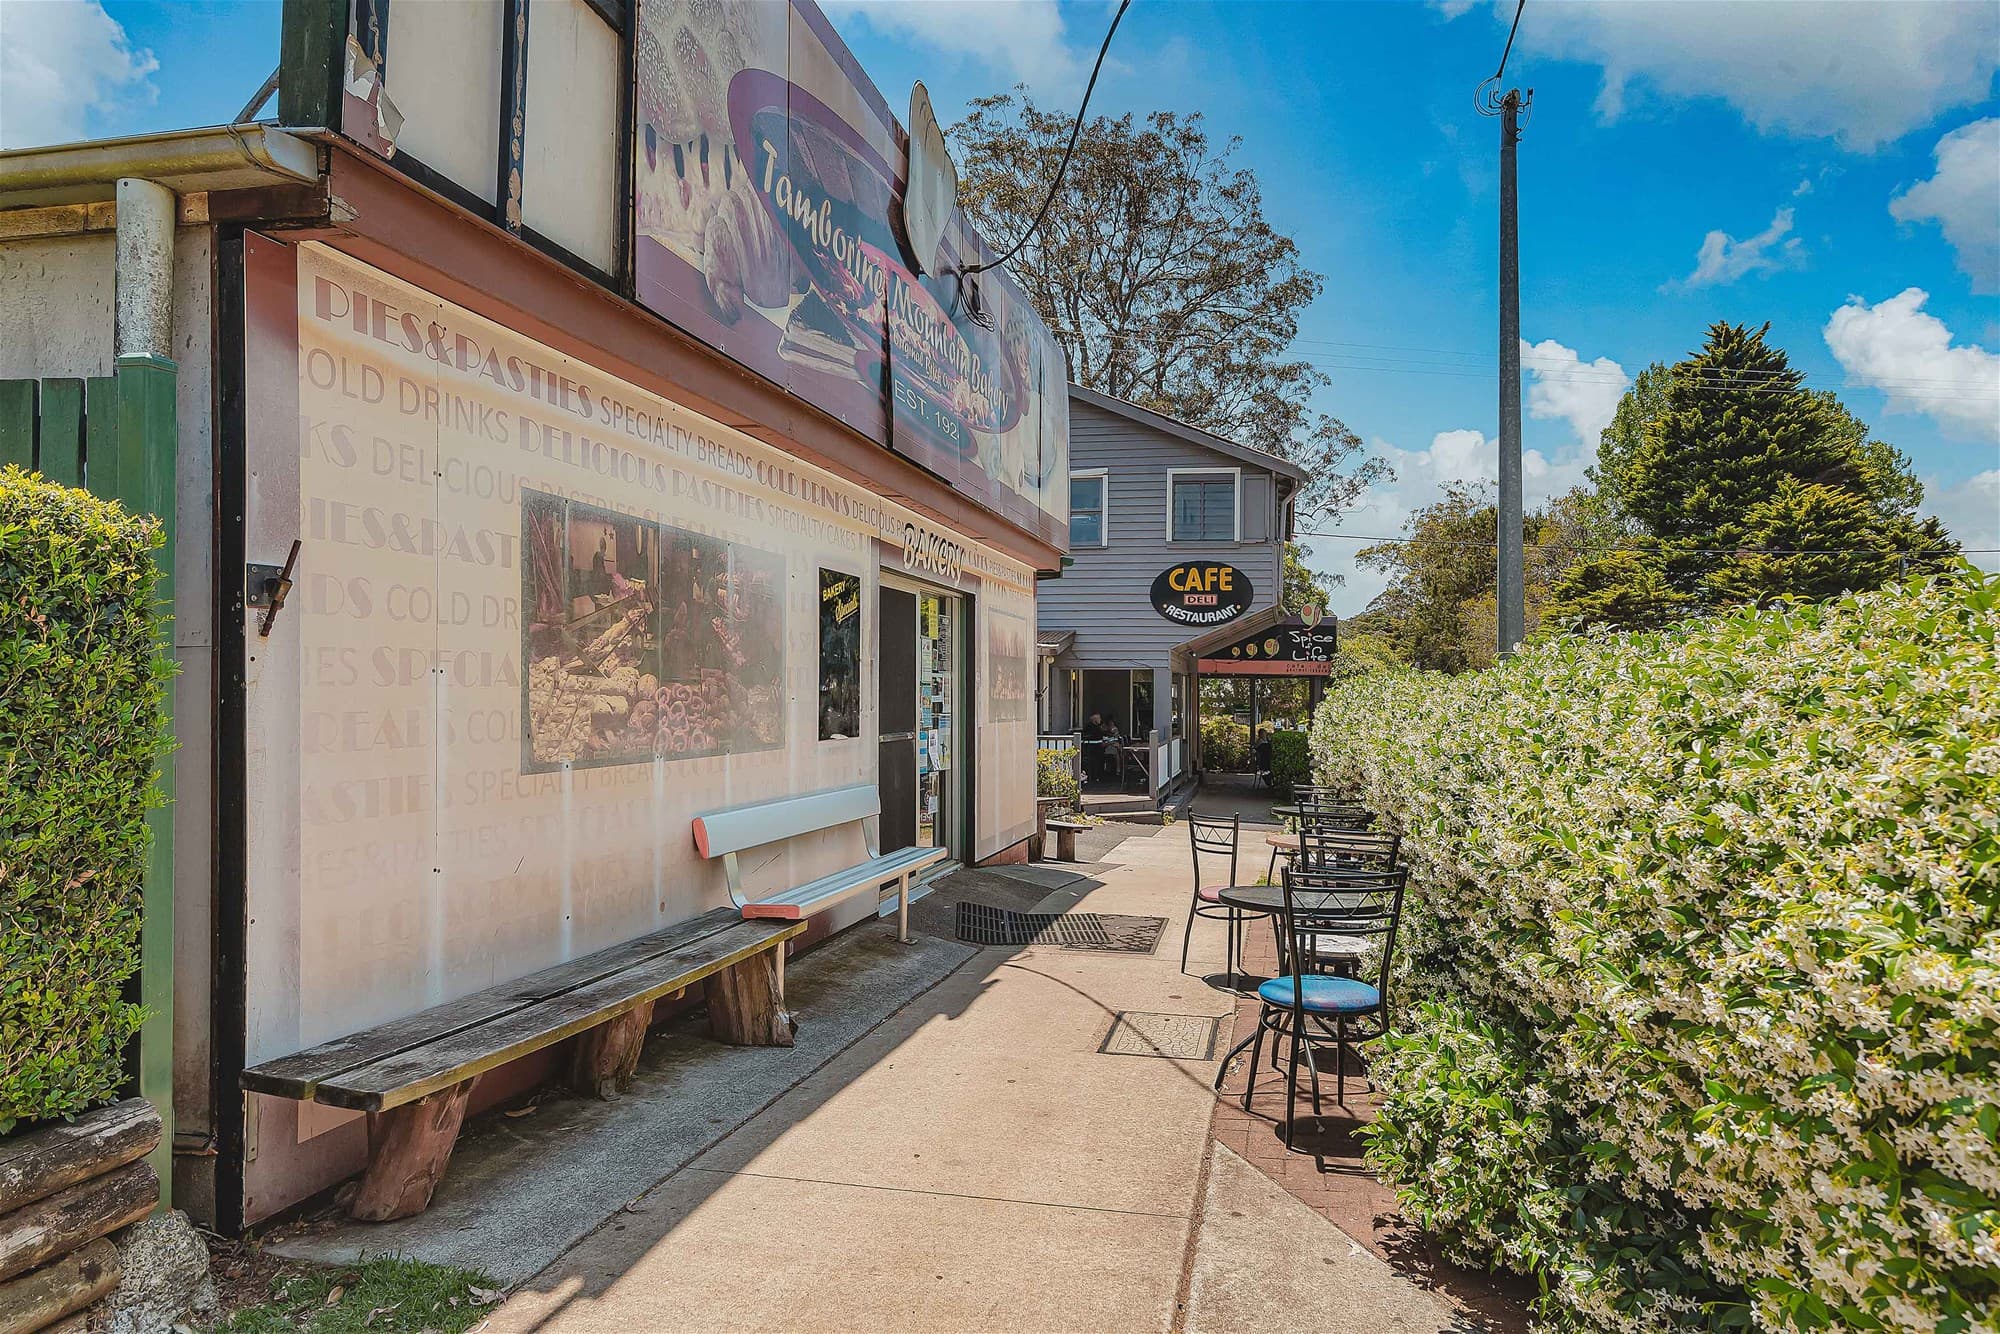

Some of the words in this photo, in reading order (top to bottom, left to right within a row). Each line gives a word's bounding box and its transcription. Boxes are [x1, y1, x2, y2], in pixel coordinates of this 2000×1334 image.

[762, 139, 885, 298] Tamborine
[892, 276, 970, 380] Mountain
[970, 353, 1009, 421] Bakery
[315, 275, 593, 418] PIES&PASTIES
[600, 395, 693, 457] SPECIALTY
[697, 435, 753, 480] BREADS
[757, 459, 799, 497] COLD
[802, 478, 850, 516] DRINKS
[852, 500, 895, 535] DELICIOUS
[894, 379, 929, 419] EST.
[936, 410, 960, 440] 192
[300, 344, 385, 404] OLD
[399, 376, 510, 444] DRINKS
[519, 415, 665, 496] DELICIOUS
[672, 468, 764, 522] PASTRIES
[767, 503, 825, 540] SPECIALTY
[827, 522, 857, 552] CAKES
[822, 580, 846, 602] BAKERY
[1168, 567, 1233, 592] CAFE
[300, 572, 373, 619] DS
[482, 595, 519, 631] DR
[1165, 604, 1238, 623] RESTAURANT
[1187, 596, 1214, 604] DELI
[1288, 630, 1334, 648] Spice
[1292, 646, 1328, 662] Life
[371, 645, 520, 688] SPECIA
